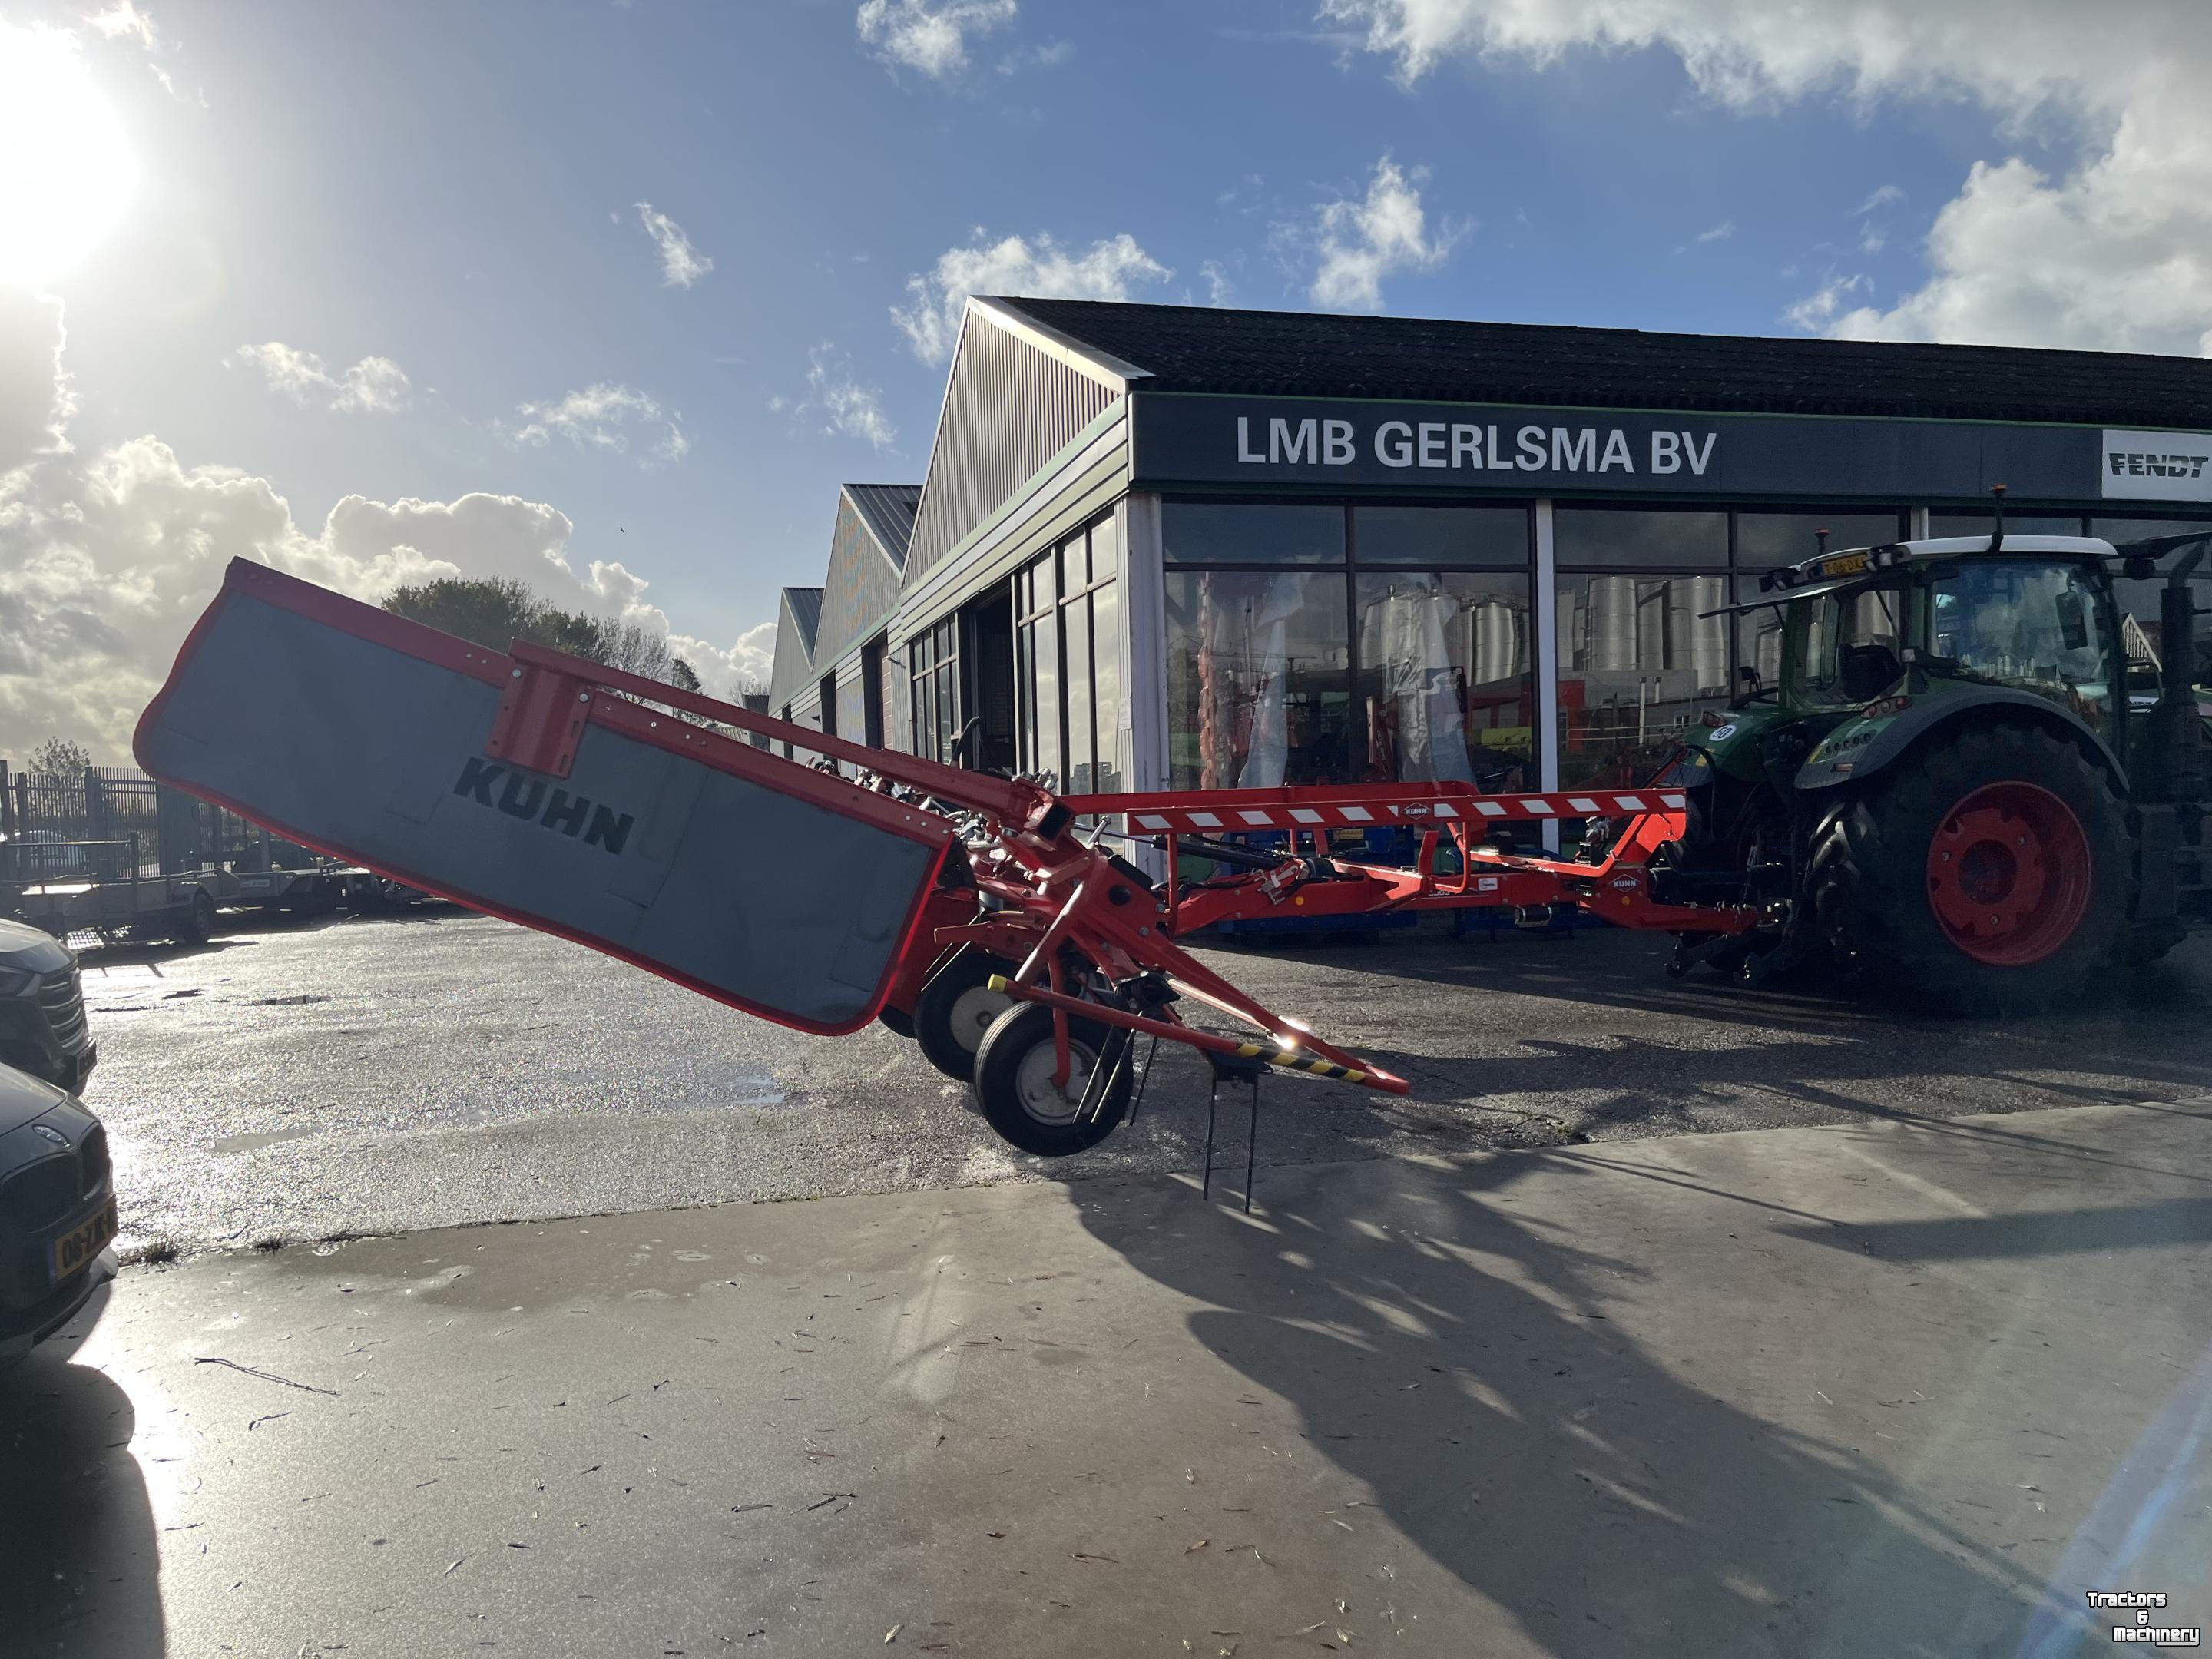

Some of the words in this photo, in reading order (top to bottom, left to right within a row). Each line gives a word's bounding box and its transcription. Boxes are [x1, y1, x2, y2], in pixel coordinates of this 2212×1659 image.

[1237, 416, 1356, 465] LMB
[1374, 420, 1634, 473] GERLSMA
[1651, 430, 1717, 475] BV
[2109, 452, 2209, 478] FENDT
[1712, 727, 1733, 739] 50
[453, 757, 634, 856] KUHN
